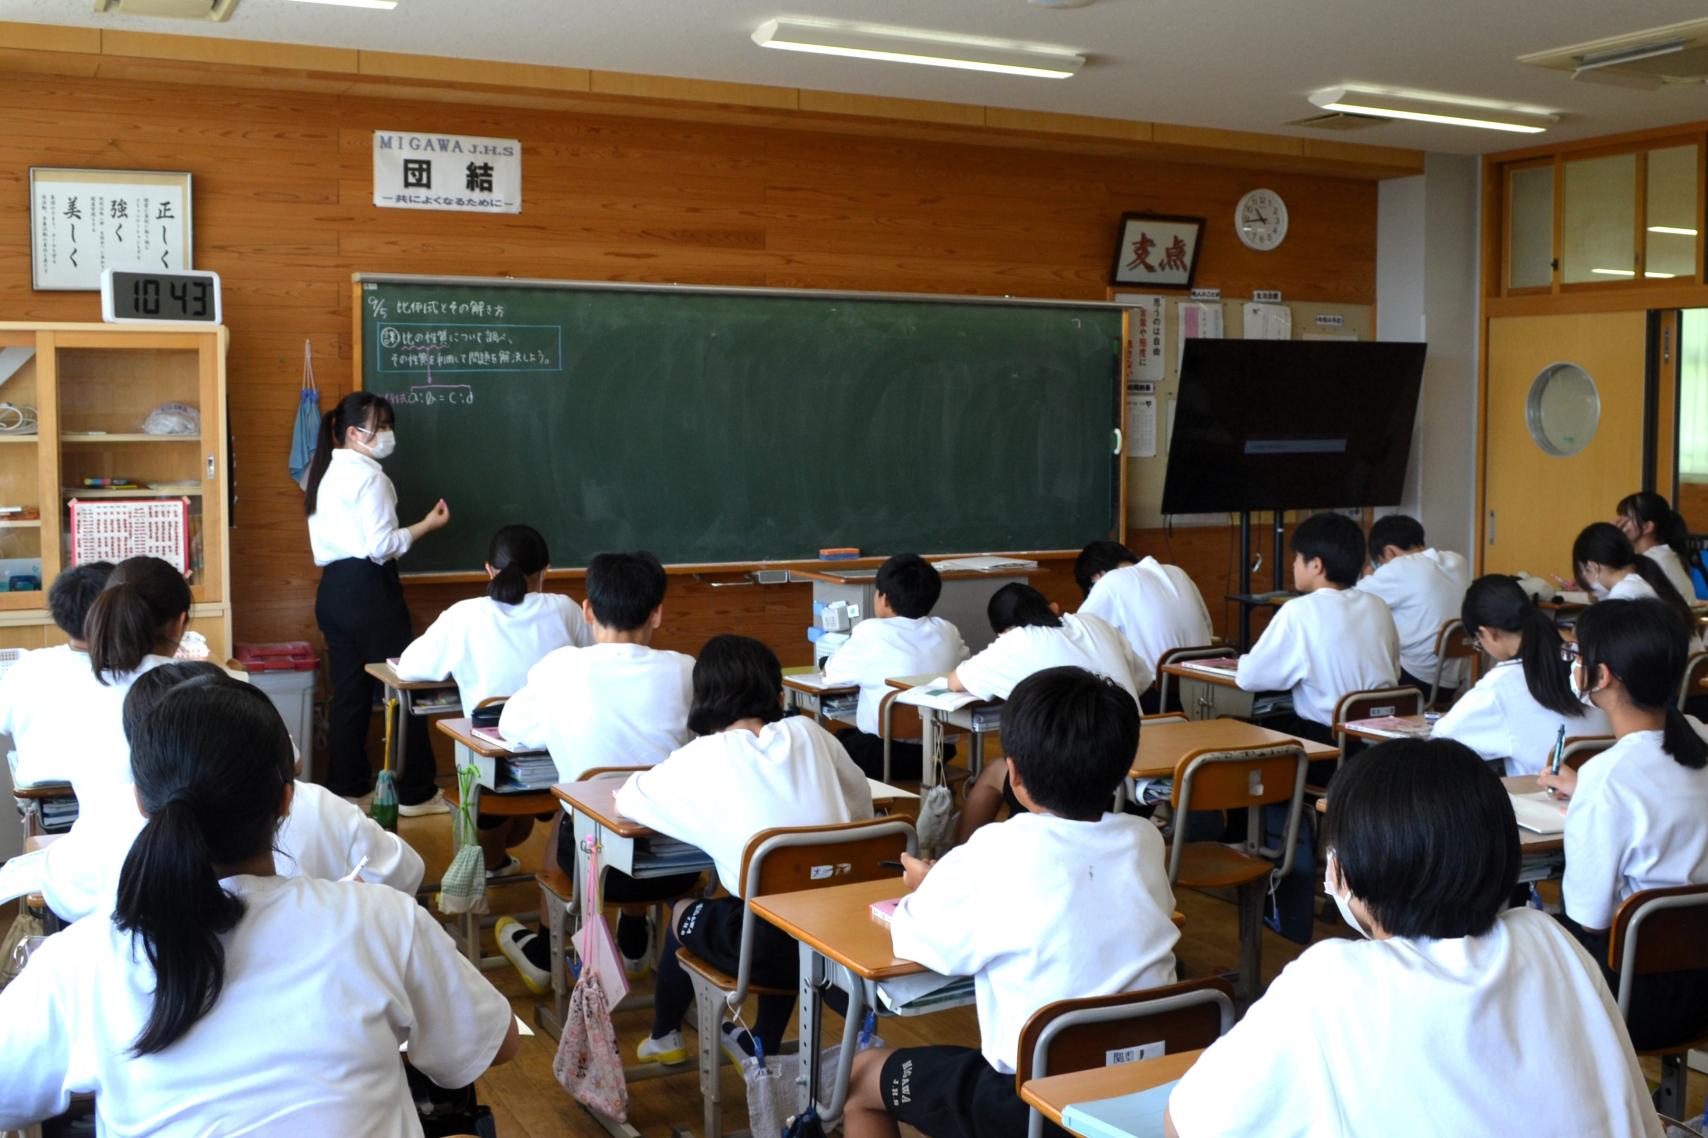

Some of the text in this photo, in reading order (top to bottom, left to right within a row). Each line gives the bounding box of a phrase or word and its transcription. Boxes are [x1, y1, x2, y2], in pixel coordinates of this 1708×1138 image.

[379, 135, 515, 156] MIGAWA J.H.S
[403, 158, 495, 193] 団 結
[63, 195, 82, 268] 美しく
[110, 198, 129, 242] 強く
[155, 200, 175, 269] 正しく
